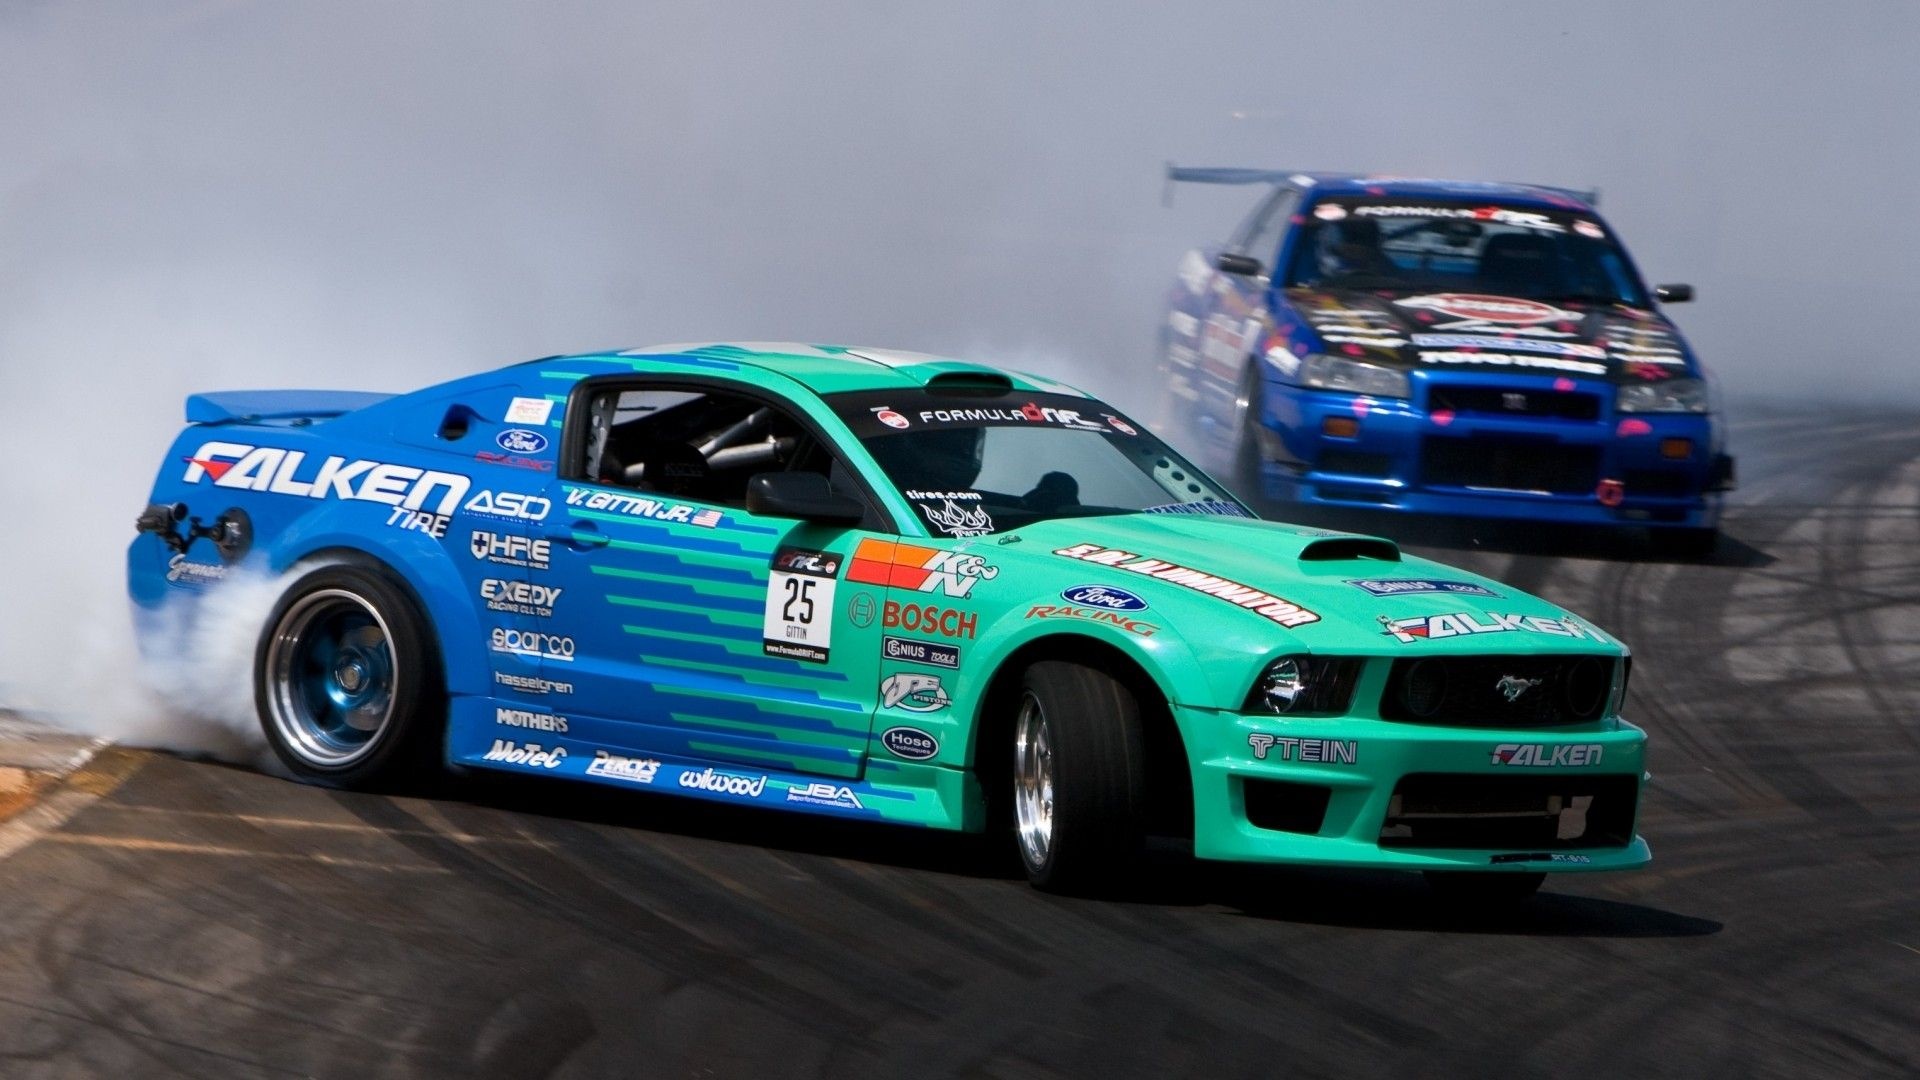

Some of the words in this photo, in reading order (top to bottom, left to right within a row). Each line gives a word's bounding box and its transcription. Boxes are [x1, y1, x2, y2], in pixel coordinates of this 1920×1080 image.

[919, 408, 1027, 423] FORMULA
[503, 431, 539, 451] Ford
[182, 441, 471, 517] FALKEN
[463, 490, 551, 521] ASD
[585, 492, 664, 517] GITTIN
[906, 489, 982, 500] tires.com
[386, 506, 450, 538] TIRE
[490, 533, 550, 562] HRE
[918, 550, 1000, 596] K&N
[480, 578, 562, 608] EXEDY
[783, 577, 817, 624] 25
[1073, 588, 1134, 608] Ford
[487, 601, 519, 613] RACING
[883, 600, 977, 639] BOSCH
[786, 625, 807, 640] GITTIN
[1024, 605, 1161, 637] RACING
[1385, 612, 1608, 643] FALKEN
[492, 627, 575, 657] sparco
[930, 652, 956, 665] TOOLS
[495, 670, 573, 694] hasselgren
[496, 708, 568, 732] MOTHERS
[891, 732, 932, 748] Hose
[891, 743, 931, 755] Techniques
[1276, 737, 1357, 763] TEIN
[482, 739, 568, 768] MoTeC
[1491, 743, 1603, 766] FALKEN
[679, 768, 768, 797] wilwood
[789, 783, 863, 809] JBA
